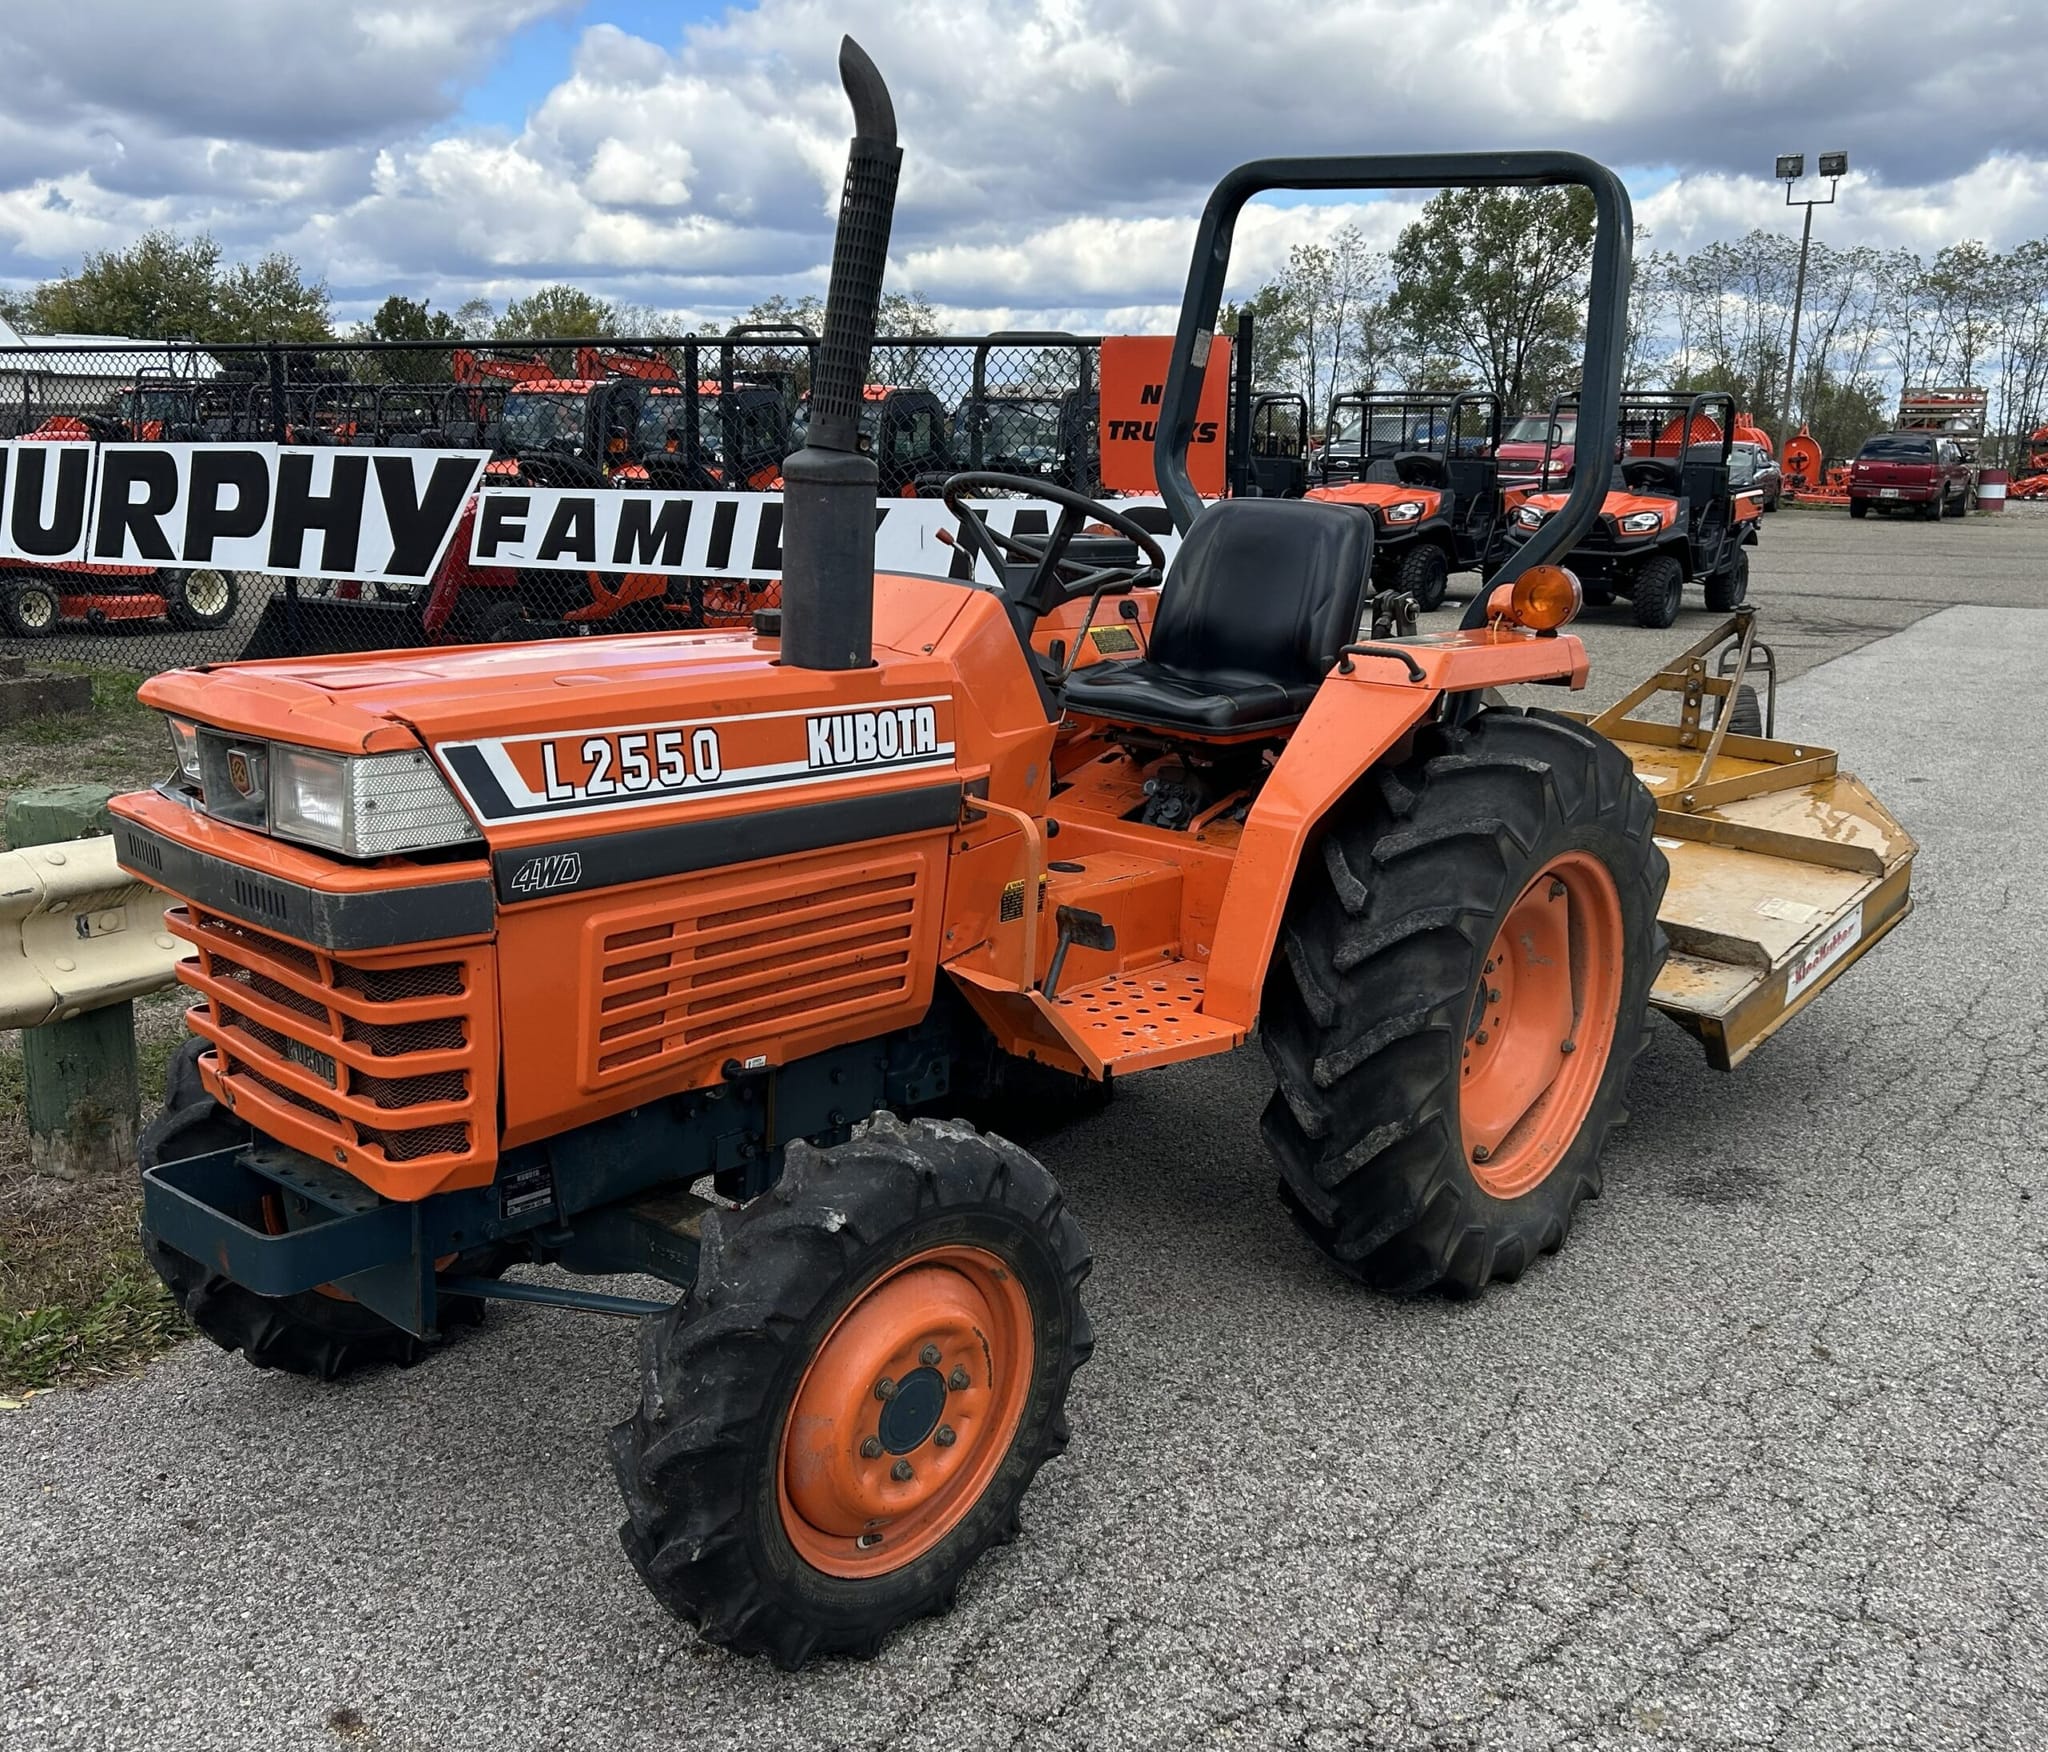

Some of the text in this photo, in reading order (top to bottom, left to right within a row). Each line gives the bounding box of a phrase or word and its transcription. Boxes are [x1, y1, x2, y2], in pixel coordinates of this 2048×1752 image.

[1108, 421, 1219, 443] TRUS
[0, 448, 482, 576] URPHY
[475, 494, 890, 570] FAMIL
[541, 727, 722, 802] L2550
[806, 704, 938, 769] KUBOTA
[511, 852, 583, 894] 4WD
